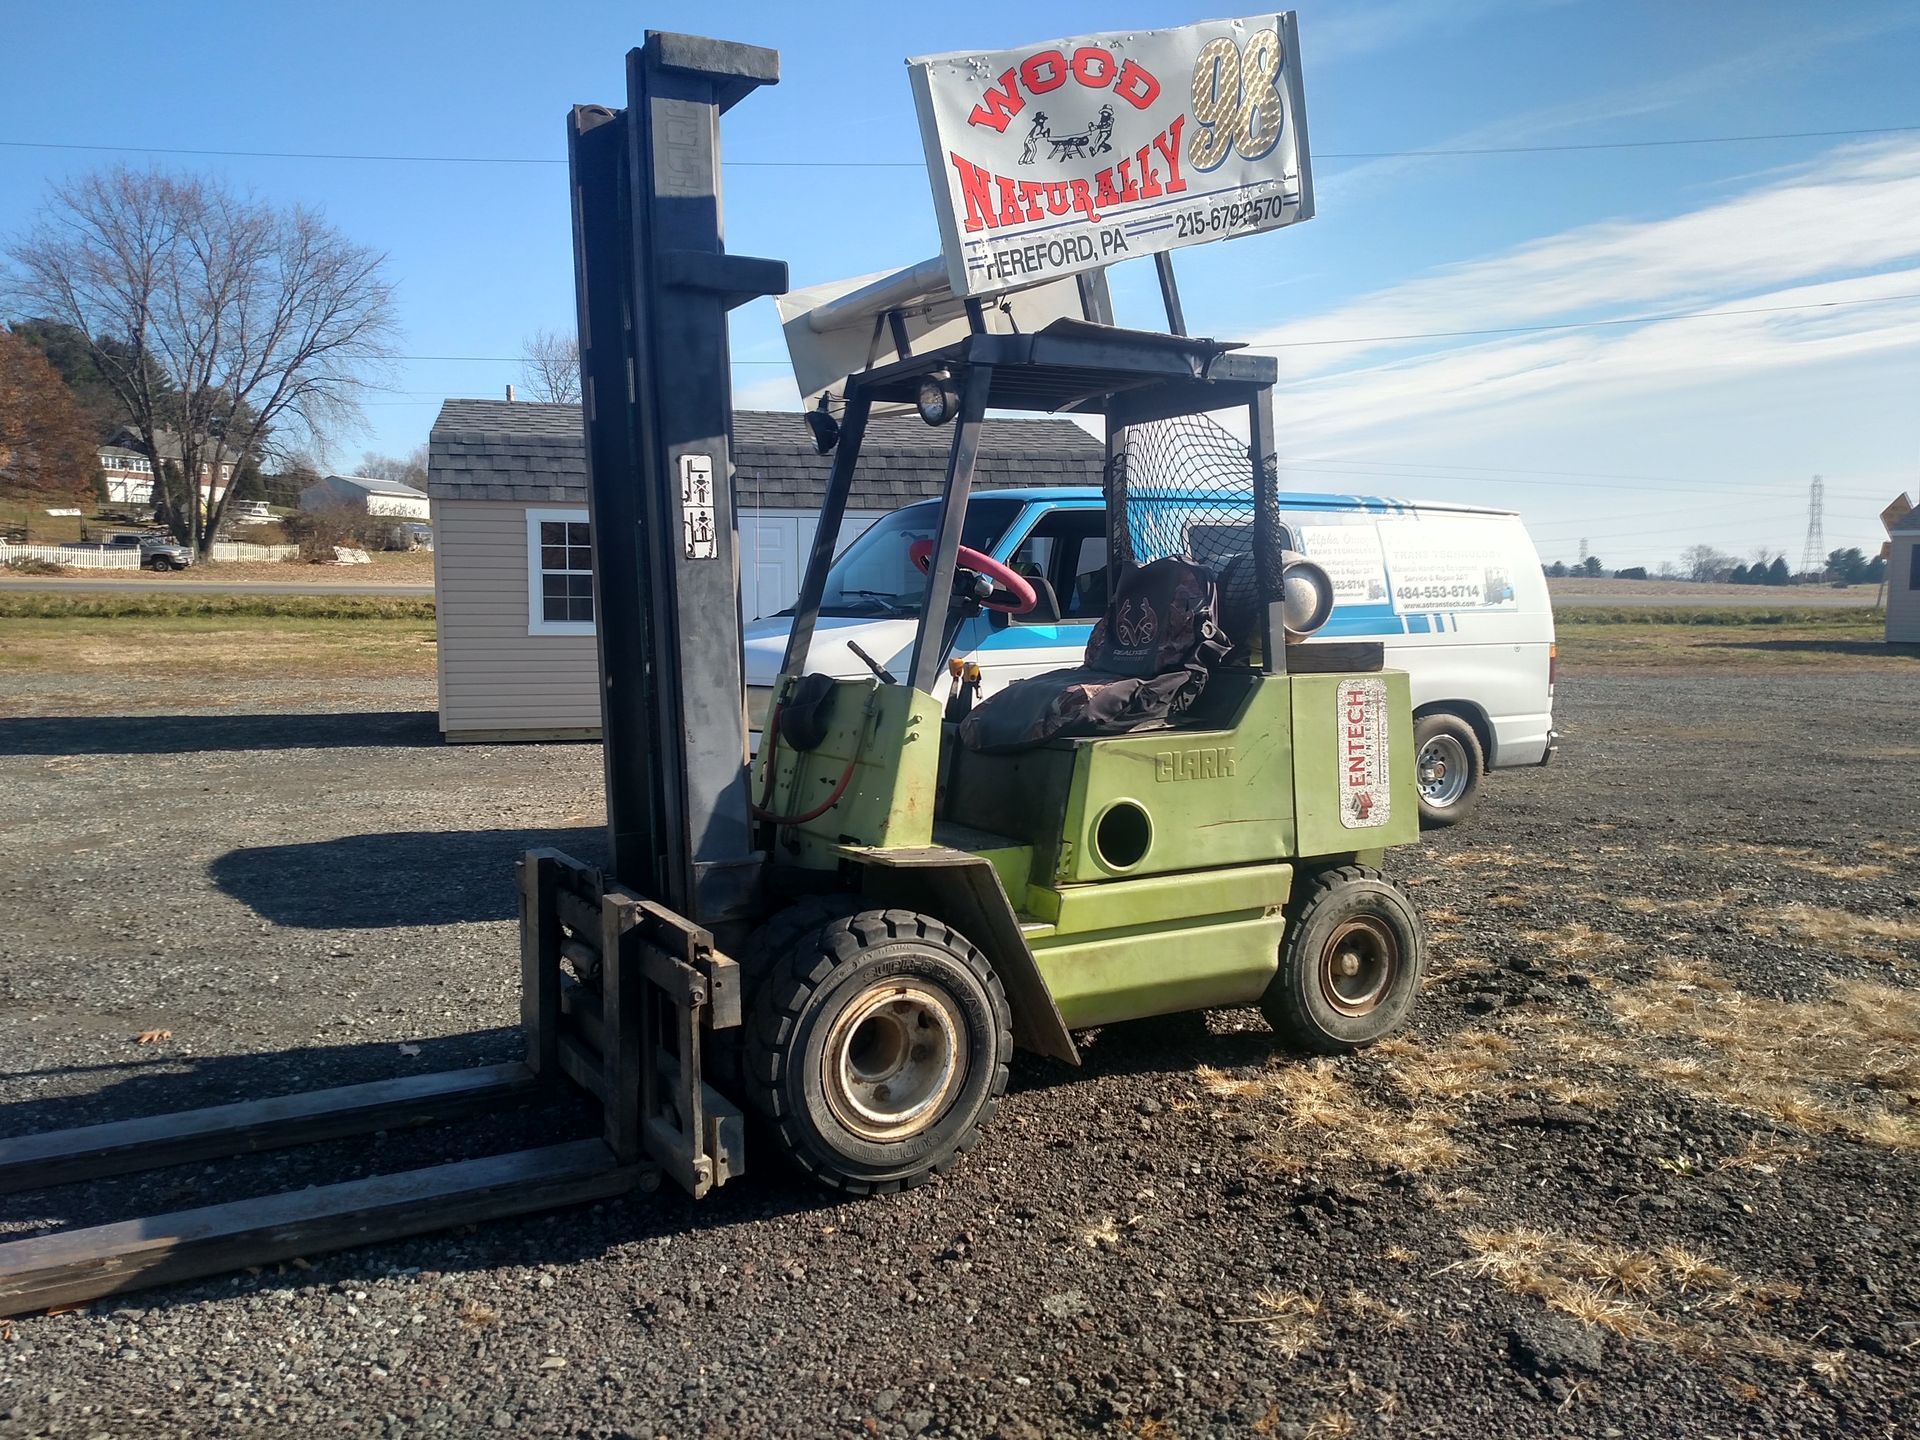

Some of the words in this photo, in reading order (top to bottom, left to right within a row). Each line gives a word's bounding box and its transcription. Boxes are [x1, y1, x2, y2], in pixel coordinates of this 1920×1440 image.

[968, 47, 1161, 133] WOOD
[1188, 29, 1284, 173] 98
[950, 114, 1187, 233] NATURALLY
[986, 235, 1099, 280] HEREFORD,
[1100, 228, 1129, 256] PA
[1396, 585, 1480, 600] 484-553-8714
[1155, 747, 1236, 783] CLARK
[1347, 690, 1366, 787] ENTECH
[1365, 690, 1373, 786] ENGINEERING
